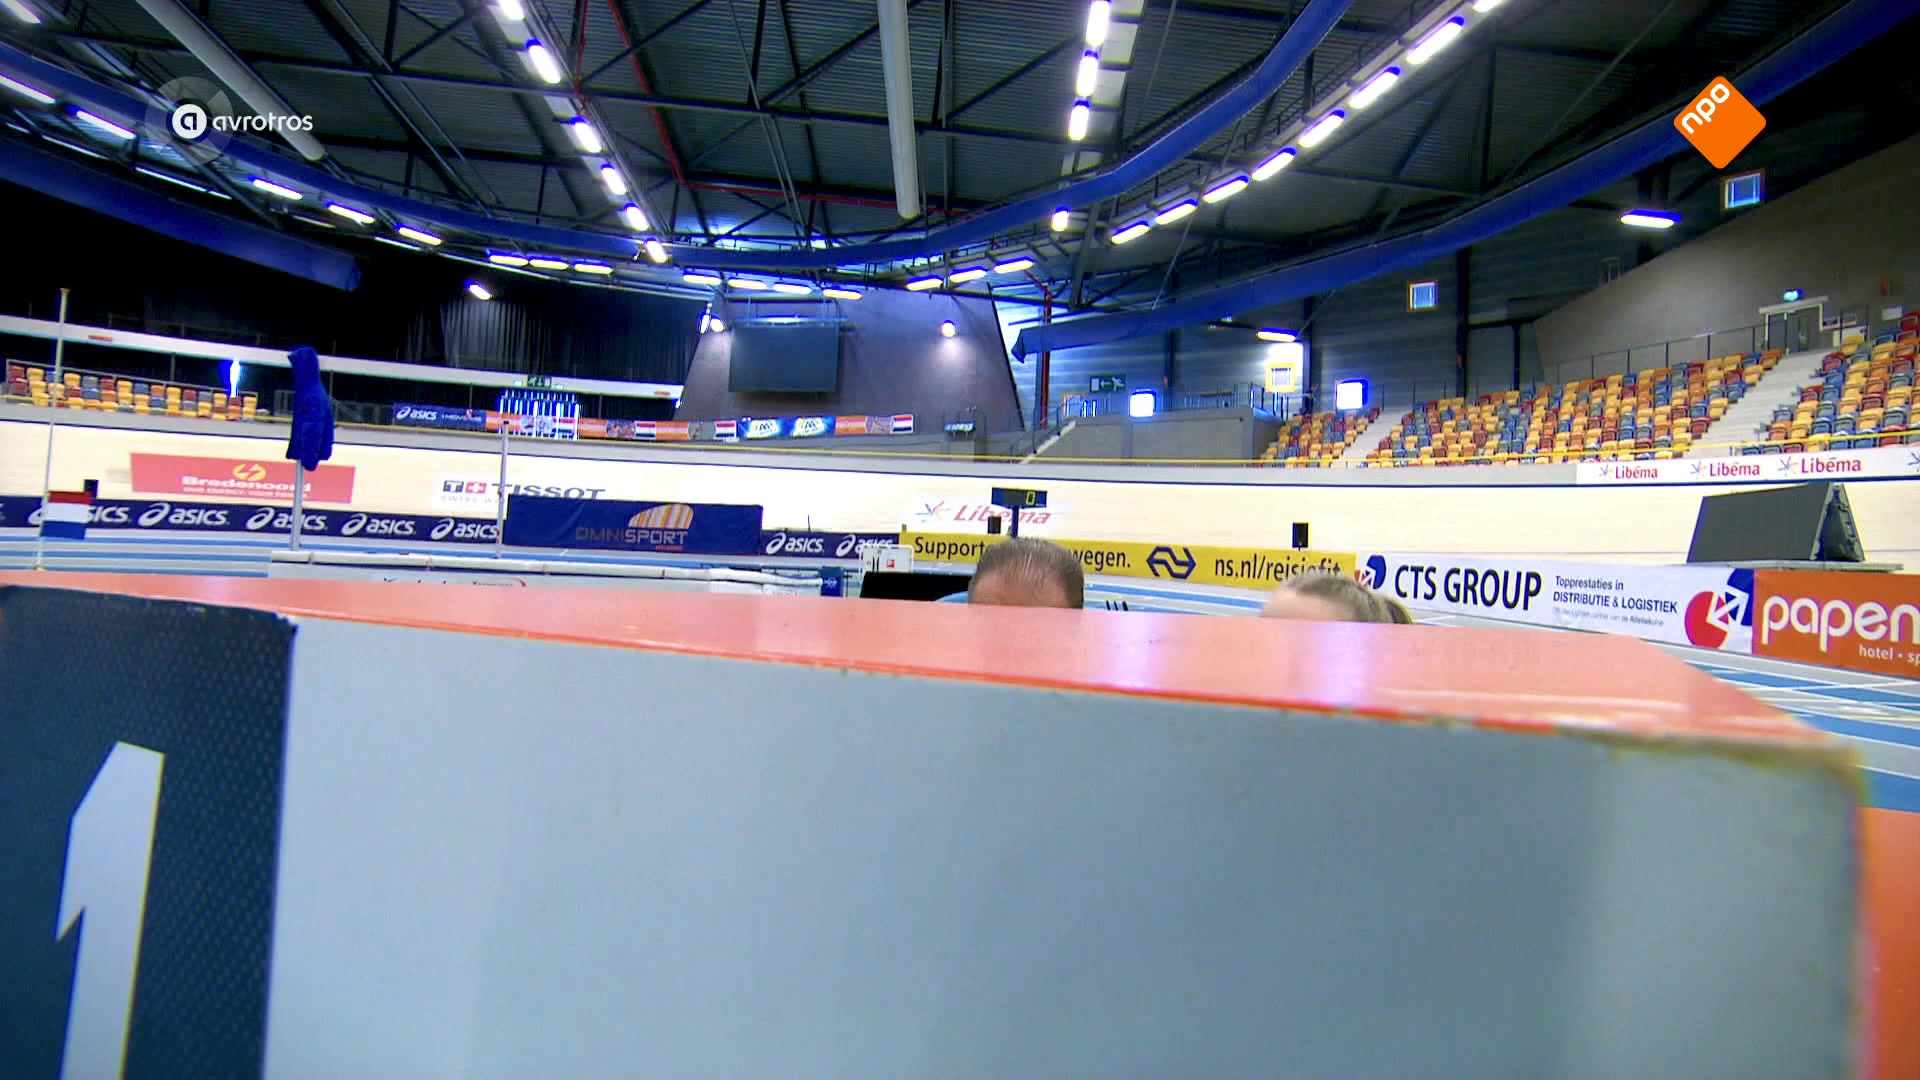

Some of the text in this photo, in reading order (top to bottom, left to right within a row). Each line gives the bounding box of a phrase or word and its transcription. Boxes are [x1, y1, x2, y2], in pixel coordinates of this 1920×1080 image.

[410, 409, 438, 420] asics
[86, 505, 130, 523] sics
[168, 507, 229, 525] asics
[366, 518, 416, 536] asics
[453, 523, 498, 540] asics
[784, 537, 824, 553] asics
[914, 536, 985, 560] Support
[1394, 563, 1542, 611] CTS GROUP
[1555, 575, 1624, 591] Topprestaties in
[1553, 591, 1678, 613] DISTRIBUTIE & LOGISTIEK
[1858, 644, 1894, 660] hotel
[56, 741, 165, 1080] 1
